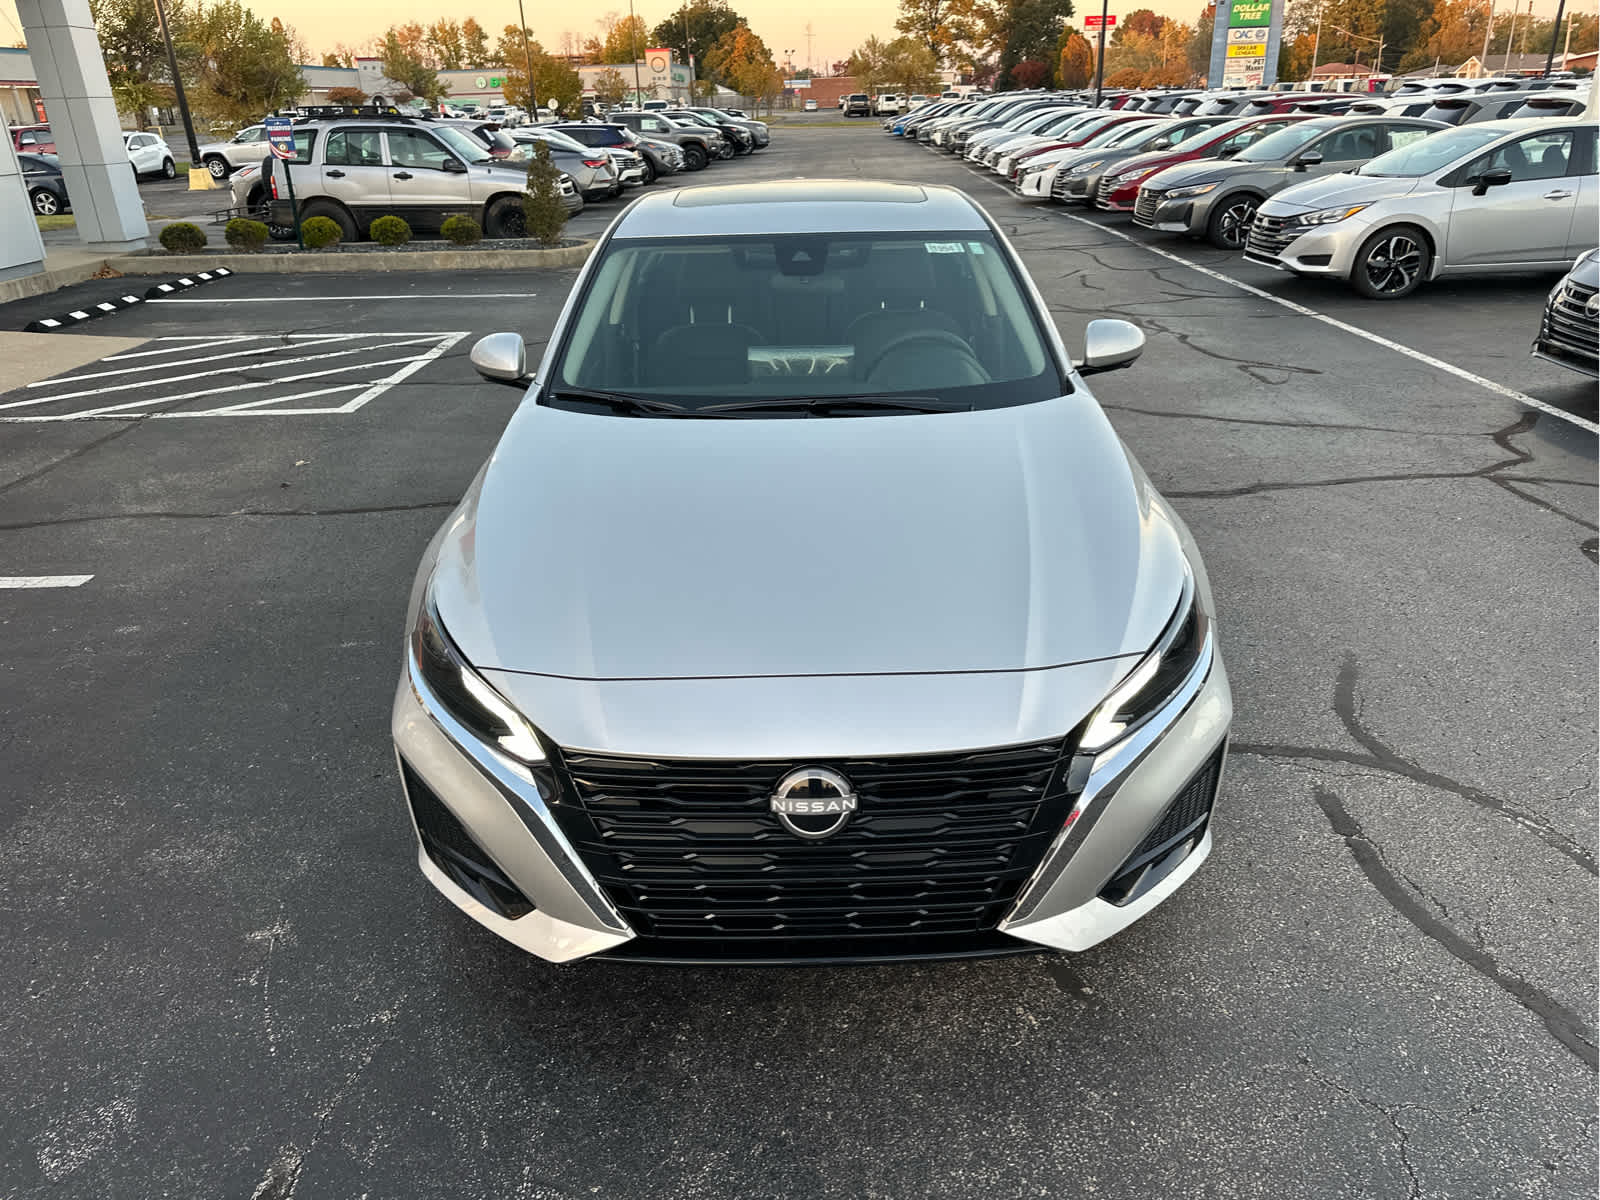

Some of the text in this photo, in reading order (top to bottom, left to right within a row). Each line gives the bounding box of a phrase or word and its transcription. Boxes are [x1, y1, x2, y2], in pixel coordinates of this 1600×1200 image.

[1233, 3, 1270, 12] DOLLAR
[1239, 12, 1262, 20] TREE
[772, 798, 856, 813] NISSAN
